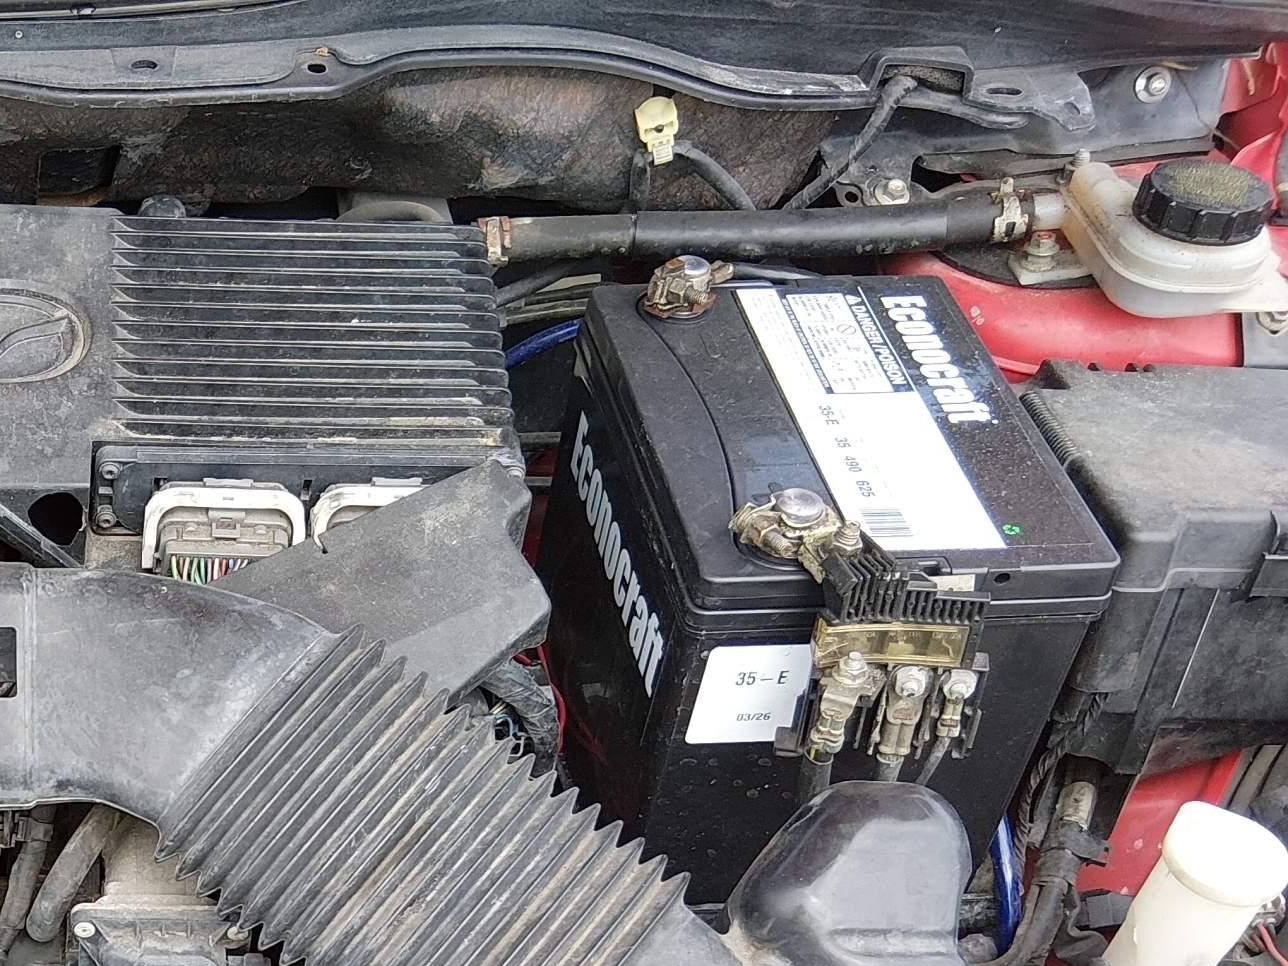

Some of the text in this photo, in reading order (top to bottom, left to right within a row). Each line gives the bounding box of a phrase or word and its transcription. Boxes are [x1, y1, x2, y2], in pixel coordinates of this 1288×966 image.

[881, 295, 991, 424] Econocraft
[844, 455, 863, 473] 490
[855, 480, 876, 498] 625
[570, 410, 664, 699] Econocraft
[735, 711, 772, 723] 03/26
